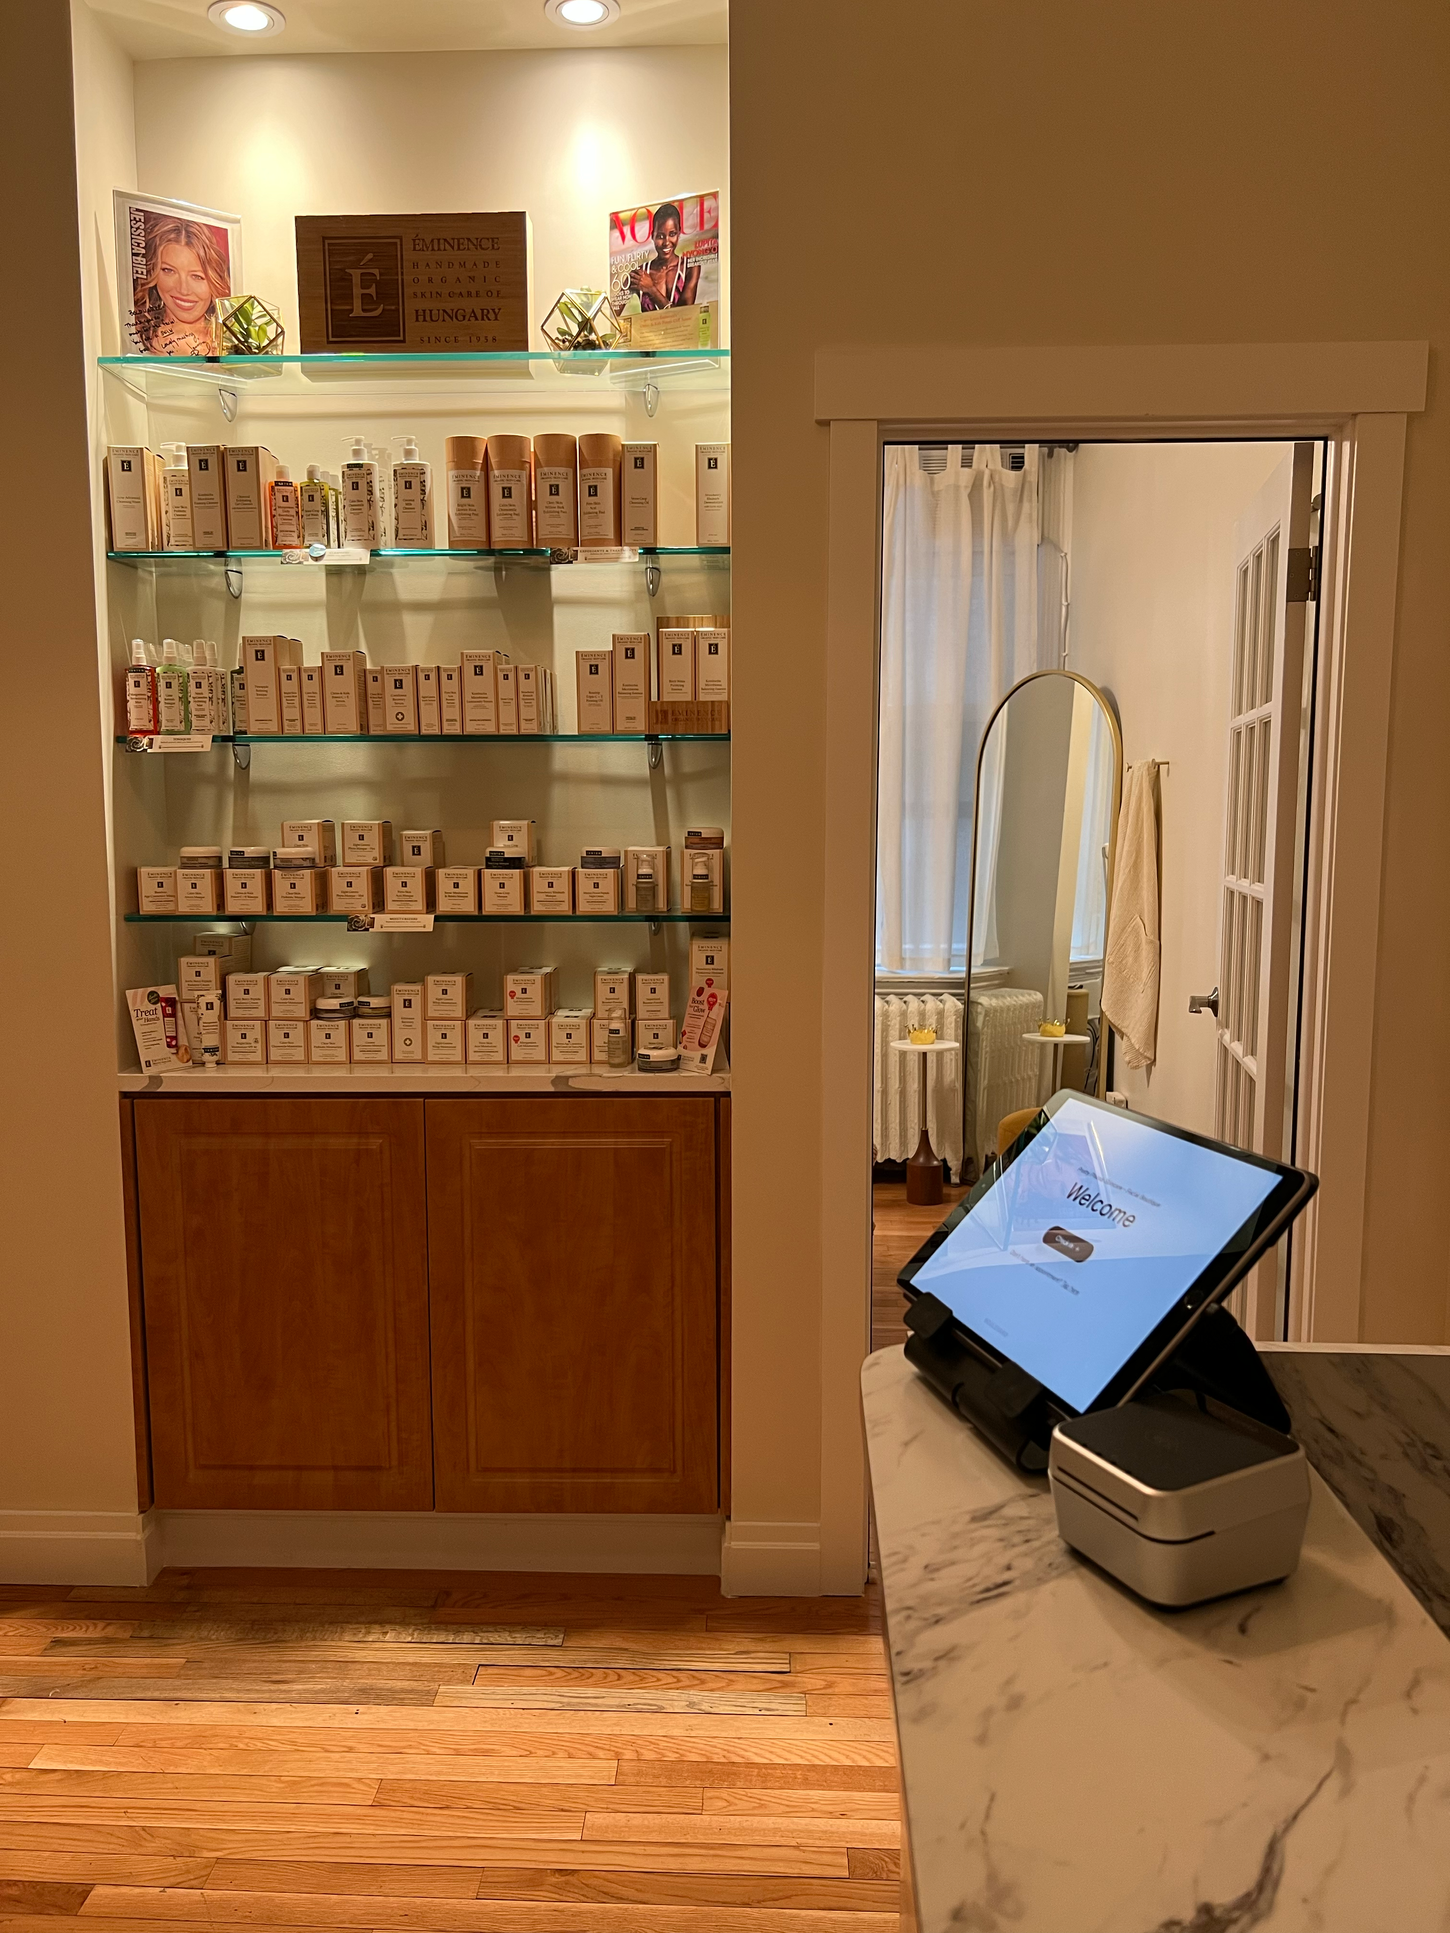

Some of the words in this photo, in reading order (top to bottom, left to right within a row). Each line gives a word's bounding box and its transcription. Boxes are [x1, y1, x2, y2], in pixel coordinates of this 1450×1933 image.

[610, 192, 718, 245] VOUE
[130, 206, 146, 254] JESSICA
[132, 256, 147, 280] BIEL
[412, 260, 501, 269] HANDMADE
[618, 261, 641, 272] COOL
[412, 275, 501, 284] ORGANIC
[611, 272, 631, 291] 60
[412, 290, 442, 299] SKIN
[448, 290, 482, 298] CARE
[486, 290, 502, 298] OF
[414, 307, 501, 322] HUNGARY
[419, 336, 459, 344] SINCE
[468, 335, 498, 344] 1958
[692, 997, 705, 1005] Boost
[134, 1007, 158, 1018] Treat
[1066, 1182, 1136, 1228] Welcome
